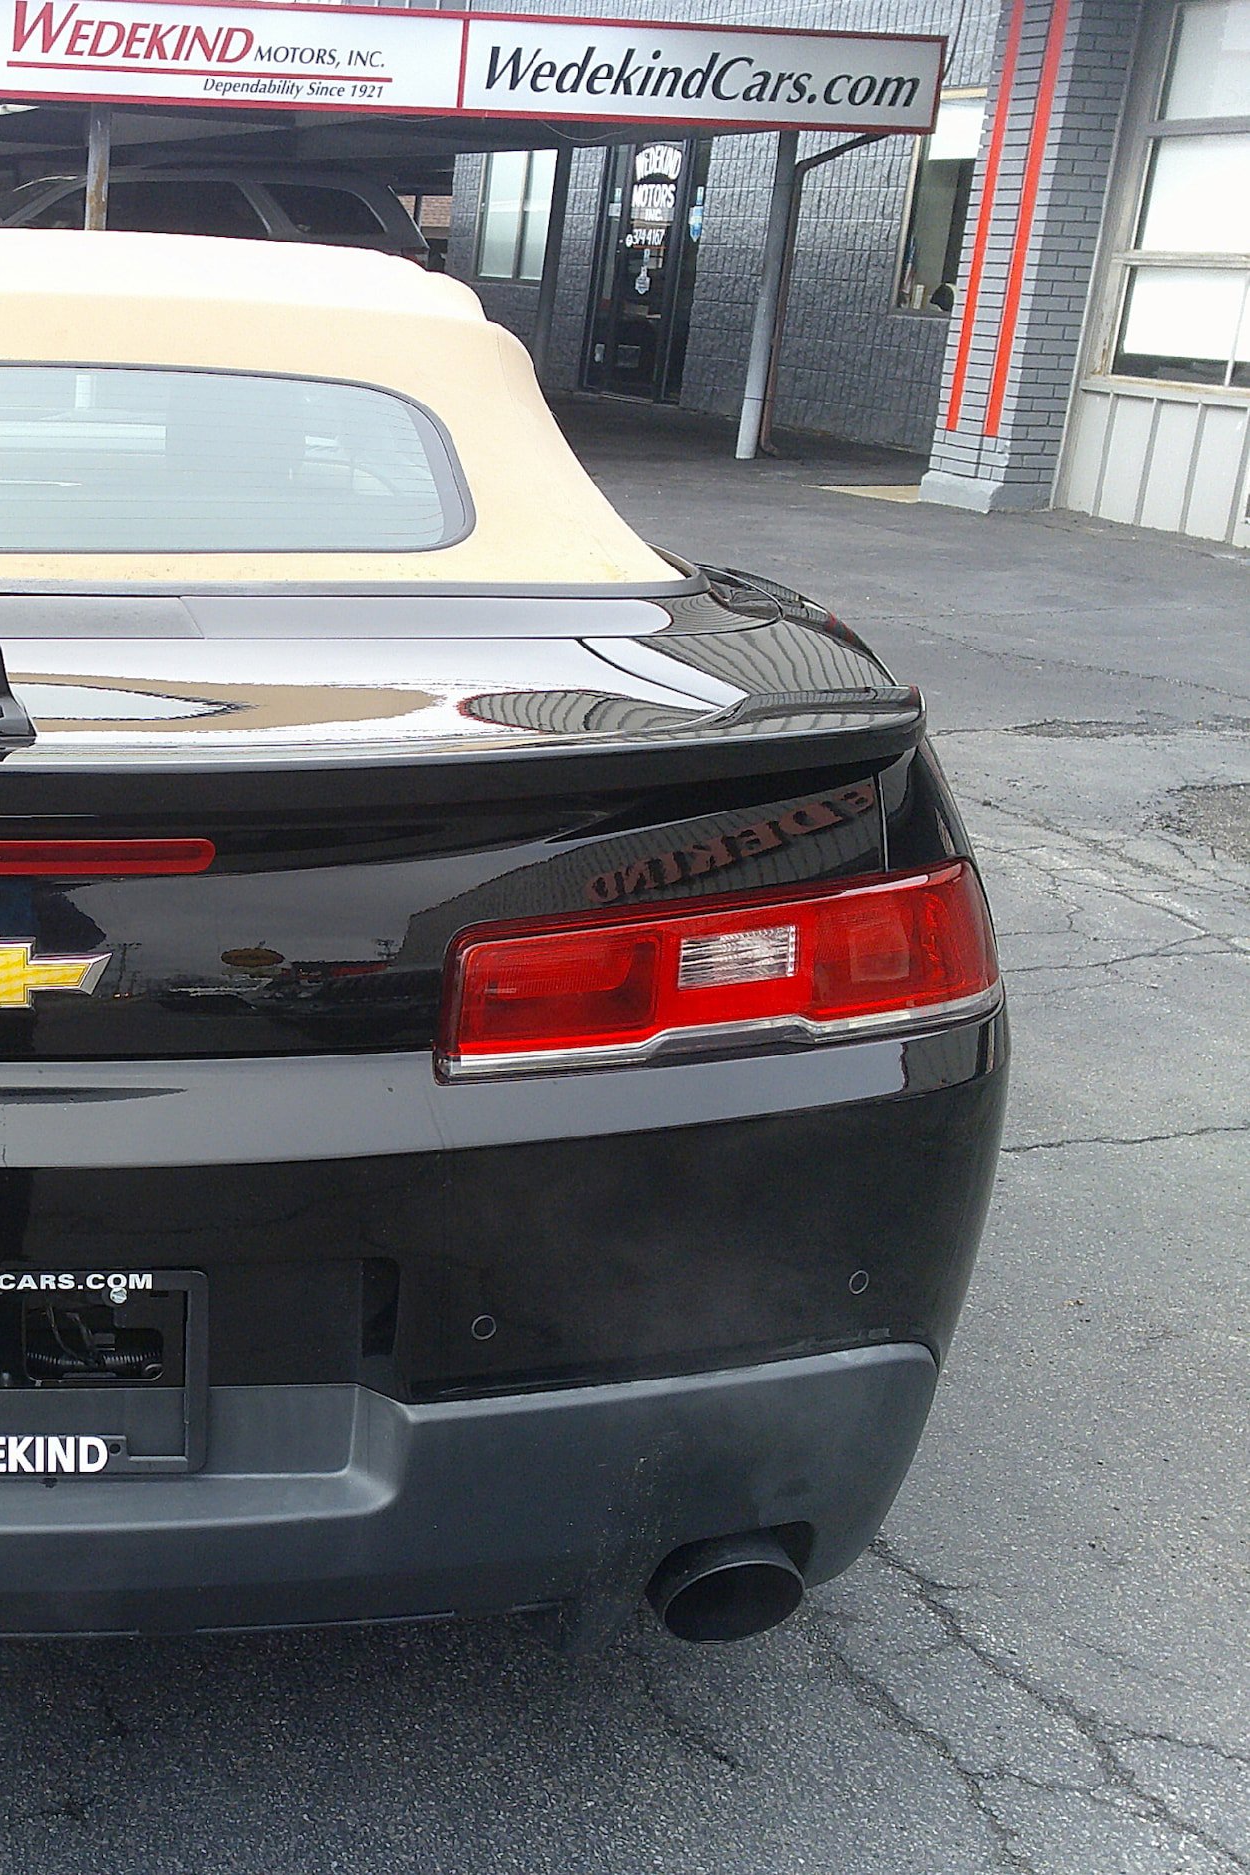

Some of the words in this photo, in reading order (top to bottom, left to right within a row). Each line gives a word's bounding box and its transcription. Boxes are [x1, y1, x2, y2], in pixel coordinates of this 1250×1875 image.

[12, 0, 253, 63] WEDEKIND
[253, 45, 341, 69] MOTORS,
[347, 49, 385, 68] INC.
[203, 78, 303, 99] Dependability
[306, 82, 346, 98] Since
[350, 84, 384, 99] 1921
[485, 46, 920, 107] WedekindCars.com
[636, 145, 682, 181] WEDEKIND
[631, 184, 676, 208] MOTORS
